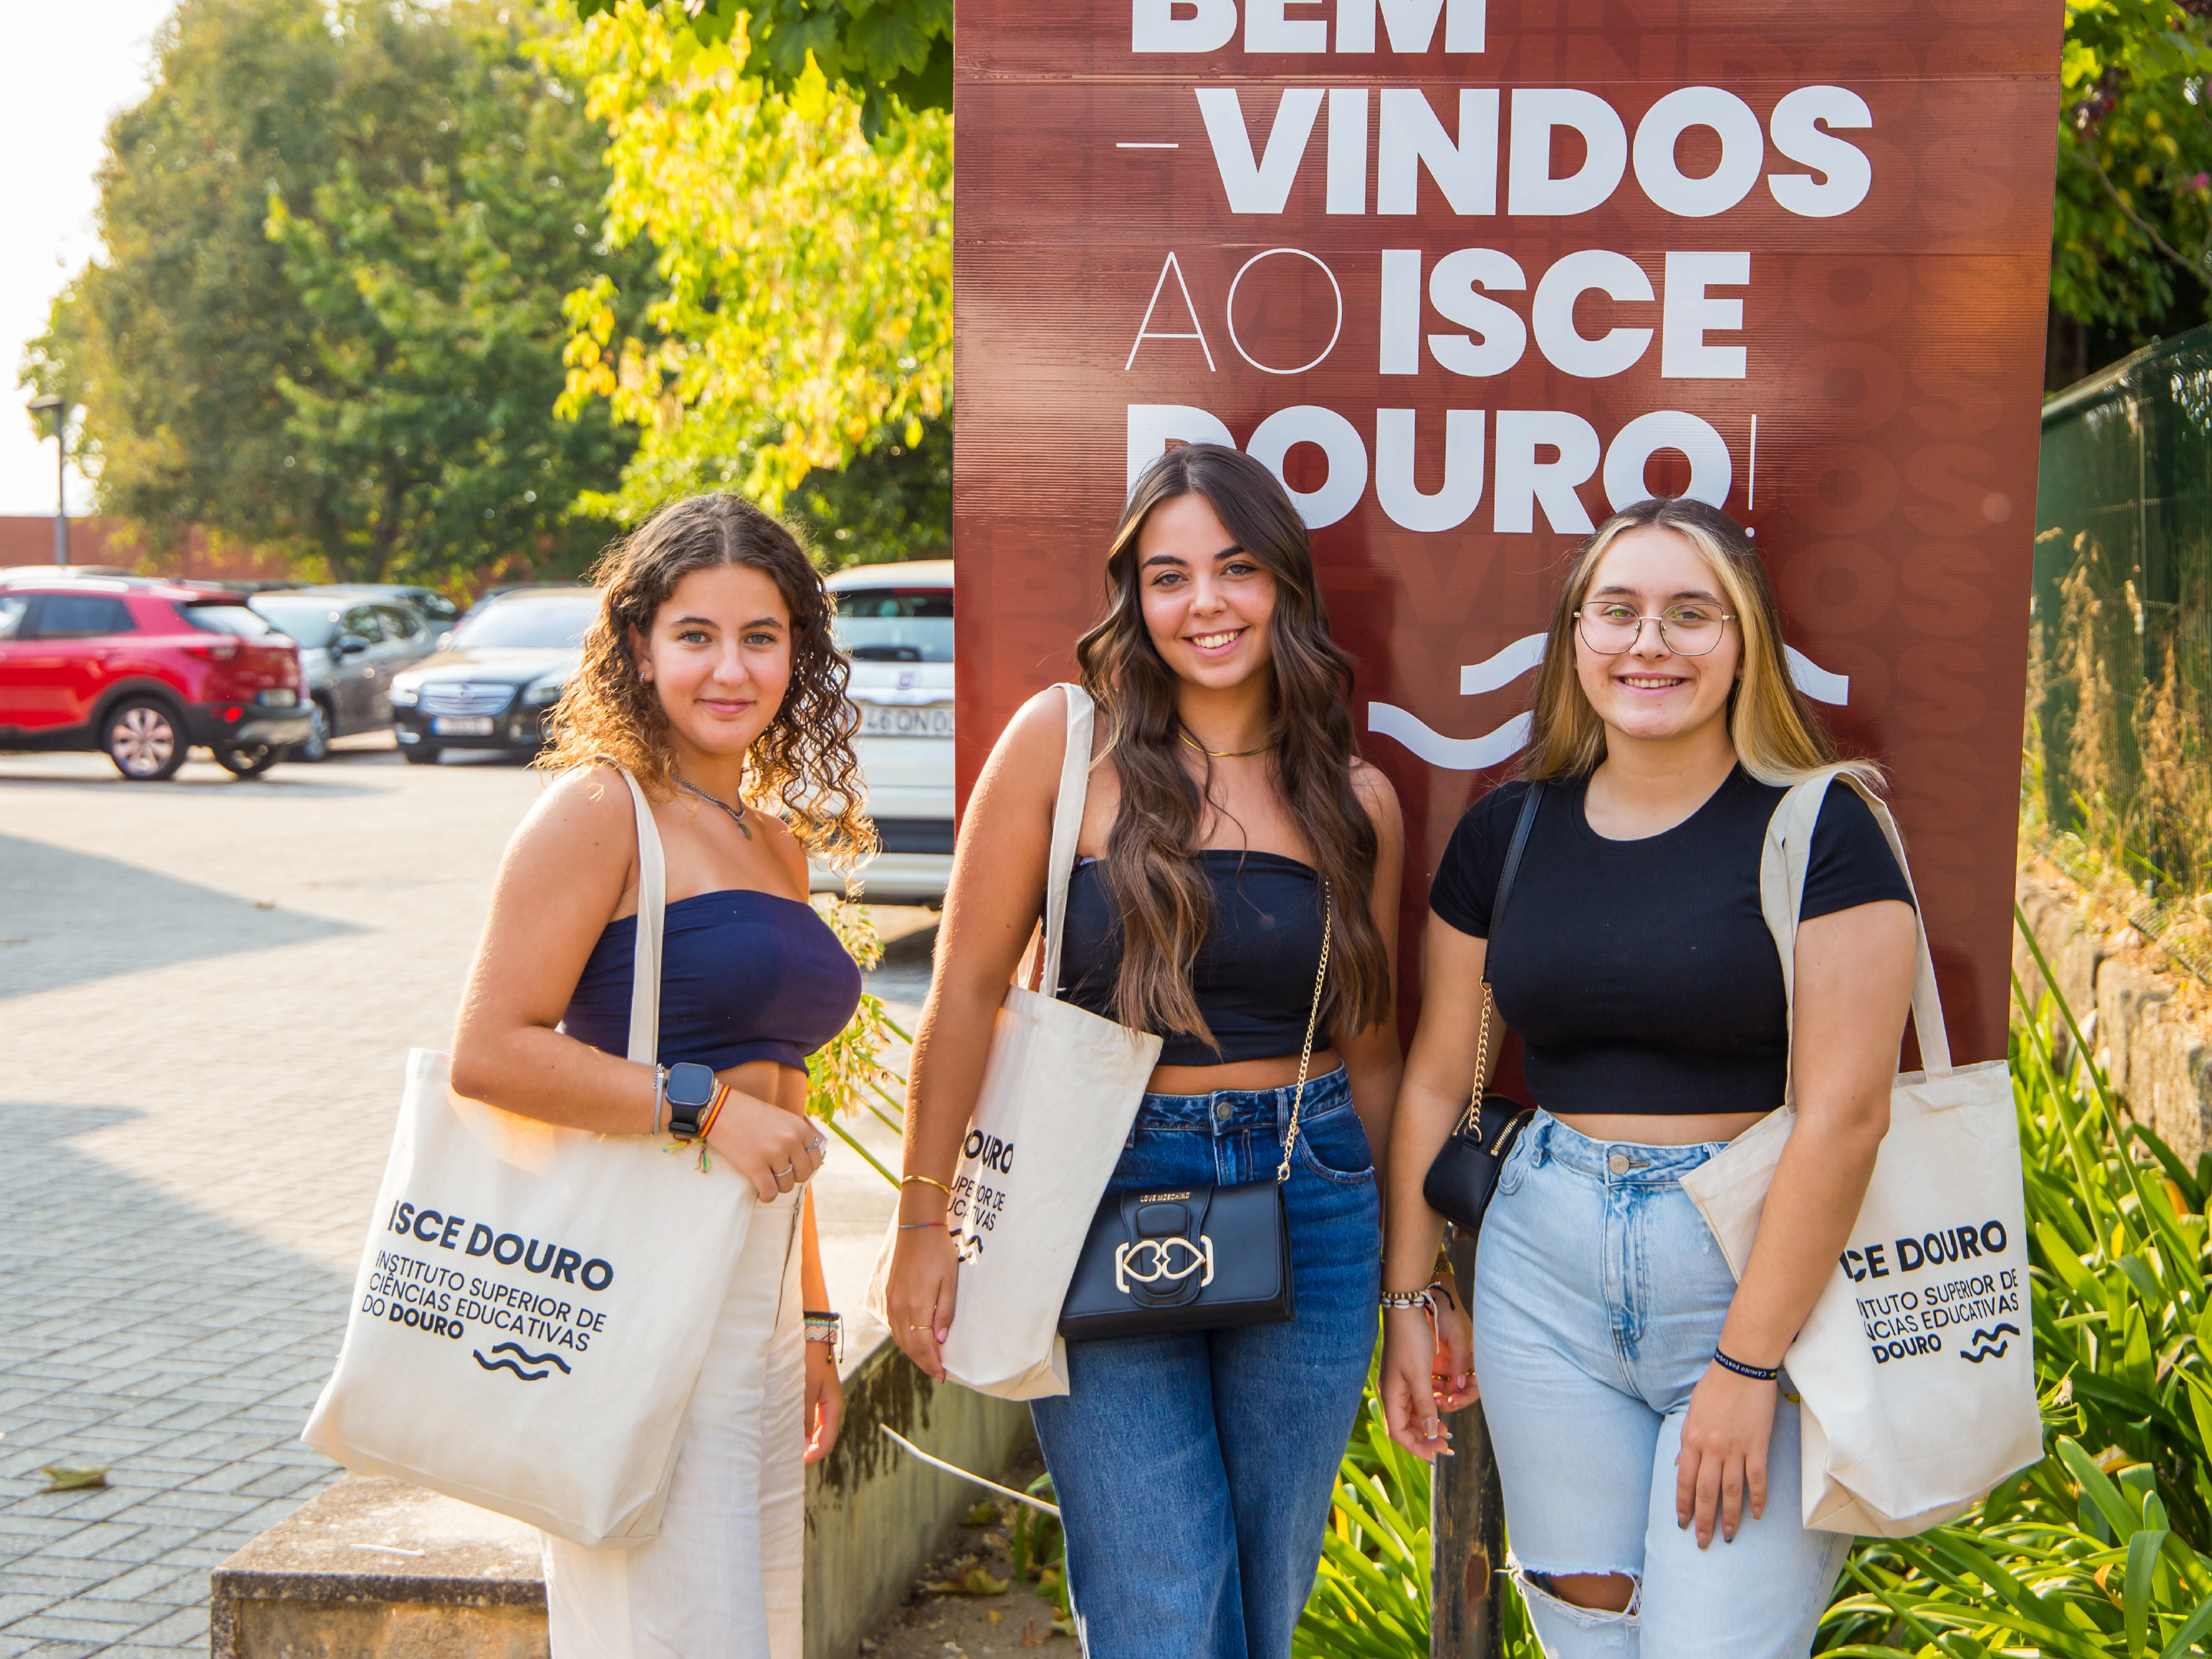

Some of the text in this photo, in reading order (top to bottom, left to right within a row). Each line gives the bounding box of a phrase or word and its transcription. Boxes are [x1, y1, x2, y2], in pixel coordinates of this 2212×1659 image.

[1125, 248, 1751, 378] AO ISCE
[387, 1200, 614, 1291] ISCE DOURO
[1895, 1220, 2008, 1273] DOURO
[370, 1272, 590, 1352] CIÊNCIAS EDUCATIVAS
[376, 1250, 607, 1333] INSTITUTO SUPERIOR DE
[1921, 1292, 2019, 1331] EDUCATIVAS
[1924, 1275, 1996, 1305] SUPERIOR
[1999, 1268, 2019, 1290] DE
[362, 1295, 464, 1340] DO DOURO
[1872, 1334, 1942, 1364] DOURO
